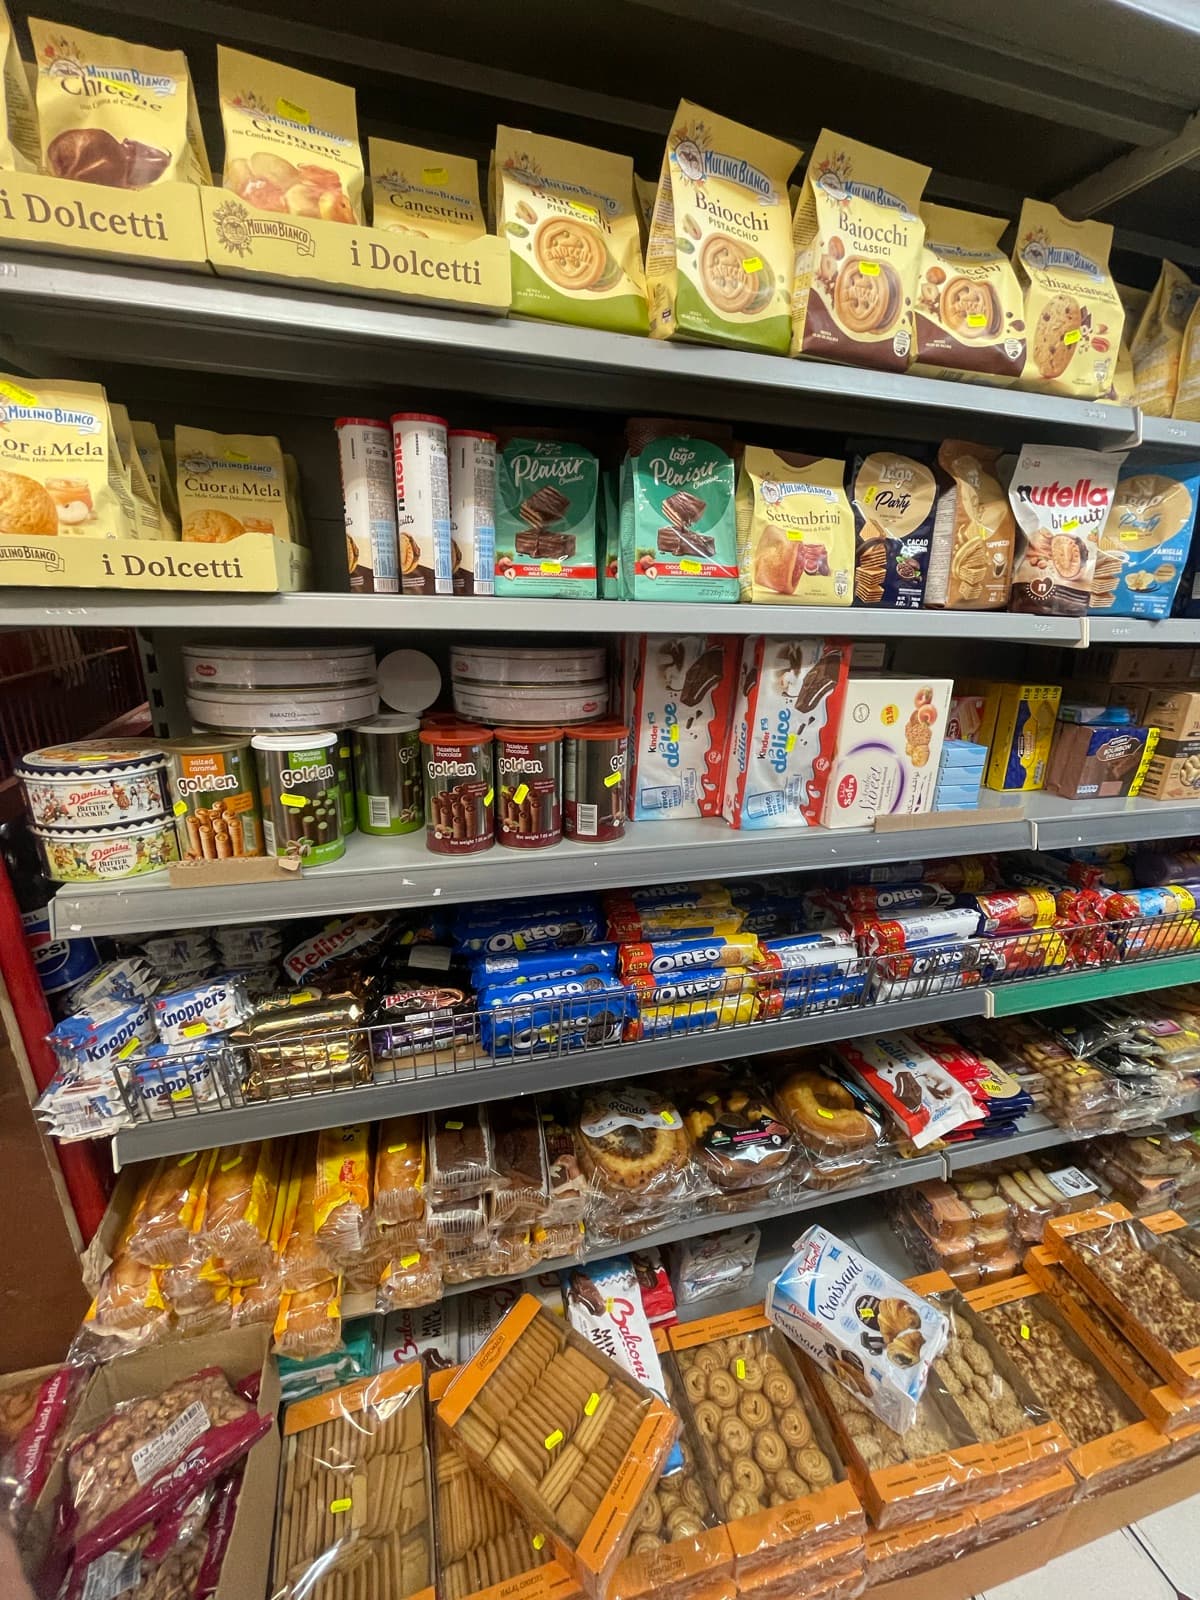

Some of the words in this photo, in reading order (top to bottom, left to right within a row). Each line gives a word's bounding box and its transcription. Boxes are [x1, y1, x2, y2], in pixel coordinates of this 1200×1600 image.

[252, 119, 342, 157] Gemme
[704, 151, 737, 181] MULINO
[738, 160, 771, 195] BIANCO
[390, 194, 475, 222] Canestrini
[845, 180, 876, 205] MULINO
[876, 186, 907, 213] BIANCO
[2, 189, 15, 220] i
[22, 193, 169, 241] Dolcetti
[695, 190, 770, 231] Baiocchi
[247, 218, 279, 237] MULINO
[278, 219, 309, 244] BIANCO
[708, 215, 759, 243] PISTACCHIO
[838, 212, 909, 248] Baiocchi
[852, 241, 891, 256] CLASSICI
[1047, 247, 1073, 267] MULINO
[1073, 251, 1098, 276] BIANCO
[351, 240, 361, 266] i
[369, 243, 482, 285] Dolcetti
[8, 405, 54, 421] MULINO
[54, 407, 94, 426] BIANCO
[32, 445, 46, 456] di
[51, 442, 103, 456] Mela
[668, 447, 696, 466] Lago
[511, 454, 584, 487] Plaisir
[649, 458, 719, 486] Plaisir
[879, 464, 914, 489] Lago
[184, 477, 228, 493] Cuor
[229, 484, 239, 494] di
[242, 484, 281, 497] Mela
[1016, 478, 1109, 508] nutella
[875, 490, 912, 514] Party
[767, 508, 841, 527] Settembrini
[24, 546, 57, 562] BIANCO
[906, 538, 929, 546] CACAO
[102, 553, 115, 576] i
[122, 554, 244, 579] Dolcetti
[648, 725, 659, 753] Kinder
[756, 731, 771, 760] Kinder
[189, 758, 215, 766] salted
[189, 764, 218, 772] caramel
[428, 761, 477, 779] golden
[499, 757, 544, 775] golden
[177, 774, 238, 796] golden
[280, 764, 334, 788] golden
[68, 788, 108, 806] Danisa
[844, 777, 855, 806] Sofra
[77, 804, 106, 812] BUTTER
[90, 843, 129, 861] Danisa
[98, 858, 127, 867] BUTTER
[877, 888, 923, 907] OREO
[486, 923, 562, 952] OREO
[650, 948, 721, 973] OREO
[160, 988, 227, 1028] Knoppers
[86, 1006, 151, 1062] Knopper
[817, 1255, 864, 1321] Croissant
[393, 1311, 418, 1364] Balco
[609, 1297, 650, 1380] Balconi
[773, 1312, 827, 1359] Croissant
